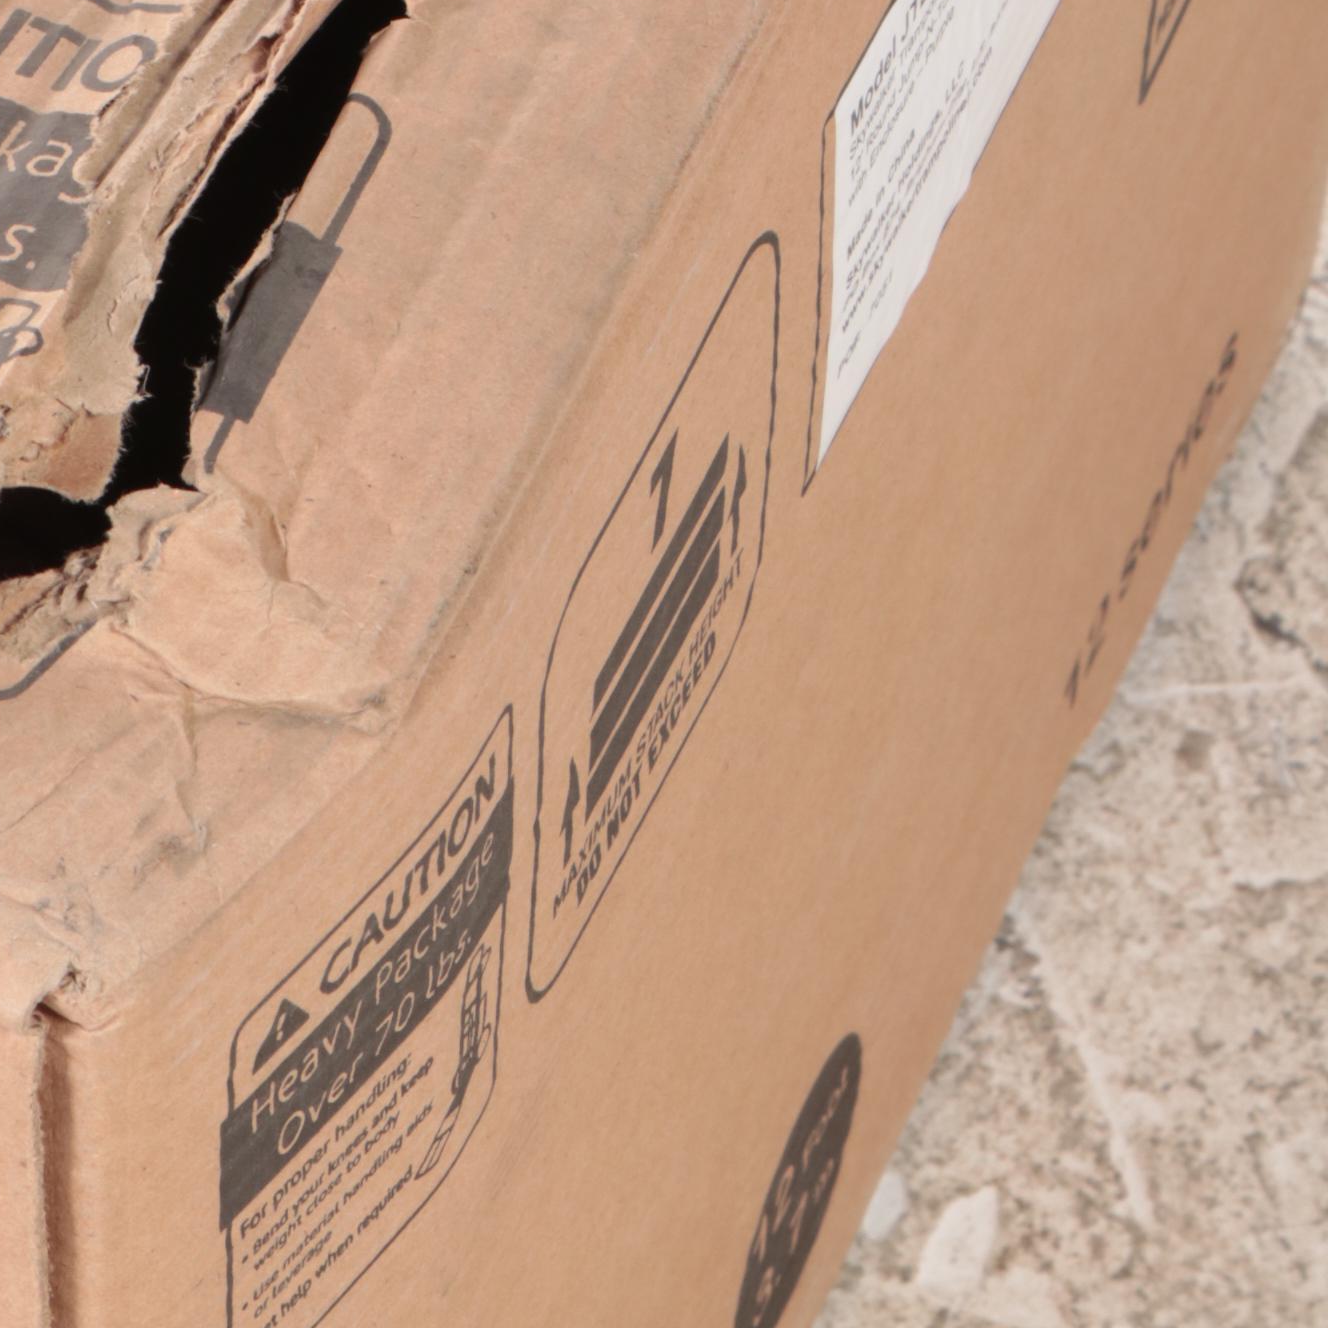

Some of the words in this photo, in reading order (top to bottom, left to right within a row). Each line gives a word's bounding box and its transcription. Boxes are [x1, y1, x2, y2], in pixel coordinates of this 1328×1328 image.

[850, 36, 895, 136] Model
[847, 207, 872, 260] Made
[887, 128, 915, 183] China
[552, 768, 633, 920] MAXIMUM
[635, 669, 686, 760] STACK
[688, 547, 745, 660] HEIGHT
[575, 847, 603, 908] DO
[605, 773, 646, 853] NOT
[648, 629, 717, 776] EXCEED
[319, 751, 496, 995] CAUTION
[251, 999, 363, 1134] Heavy
[373, 831, 495, 1005] Package
[277, 1051, 365, 1156] Over
[374, 989, 416, 1057] 70
[425, 927, 472, 1001] lbs.
[240, 1202, 268, 1240] For
[272, 1138, 331, 1208] proper
[334, 1051, 413, 1143] handling:
[253, 1208, 289, 1255] Bend
[292, 1173, 324, 1215] your
[327, 1130, 369, 1178] knees
[372, 1092, 399, 1128] and
[400, 1056, 435, 1097] keep
[253, 1213, 303, 1272] weight
[306, 1172, 344, 1217] close
[346, 1154, 362, 1173] to
[364, 1111, 401, 1153] body
[253, 1269, 280, 1301] Use
[282, 1202, 341, 1271] material
[343, 1136, 404, 1206] handling
[406, 1101, 434, 1137] aids
[280, 1277, 313, 1318] help
[315, 1233, 355, 1278] when
[357, 1163, 414, 1235] required
[254, 1301, 270, 1319] or
[272, 1230, 334, 1298] leverage
